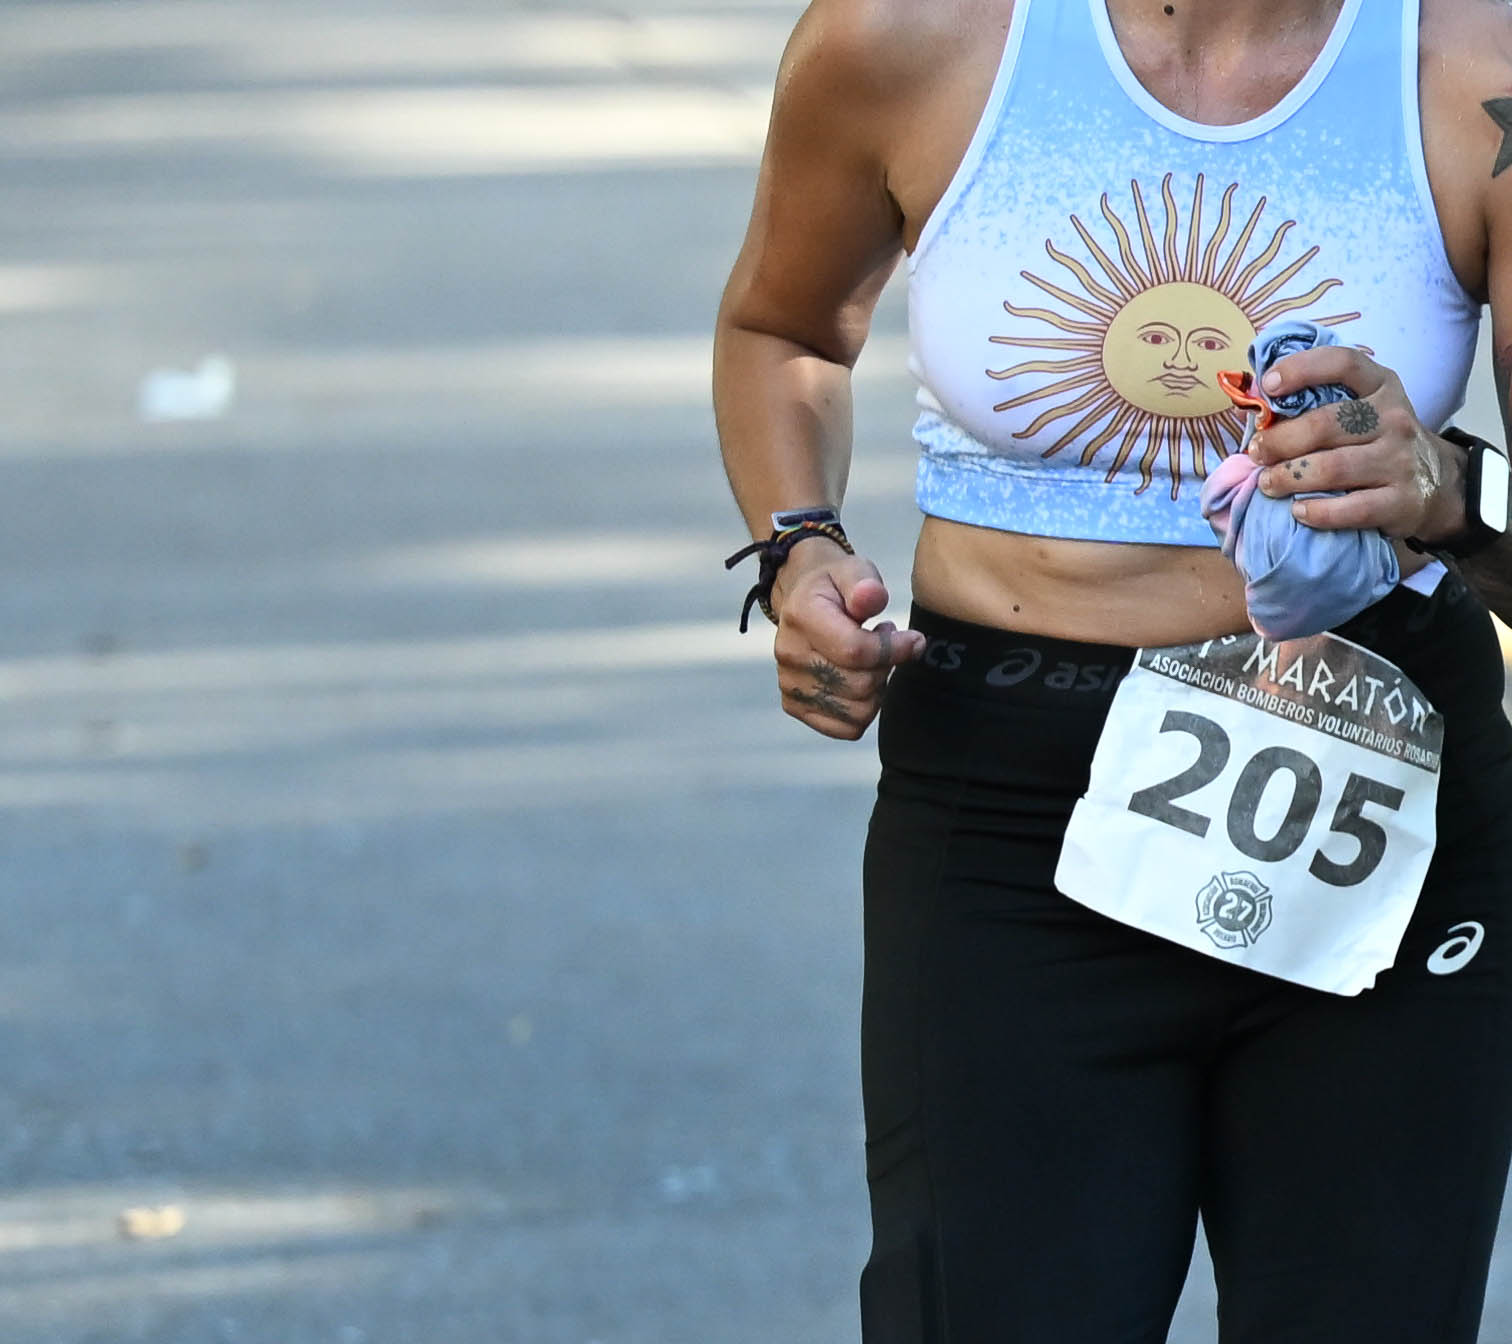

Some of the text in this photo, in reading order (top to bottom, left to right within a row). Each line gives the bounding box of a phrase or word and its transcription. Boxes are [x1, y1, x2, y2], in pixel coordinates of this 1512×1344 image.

[1149, 653, 1234, 697] ASOCIACIÓN
[1236, 682, 1314, 724] BOMBEROS
[1317, 712, 1403, 757] VOLUNTARIOS
[1242, 638, 1436, 734] MARATÓN
[1127, 709, 1406, 888] 205
[1218, 891, 1253, 922] 27
